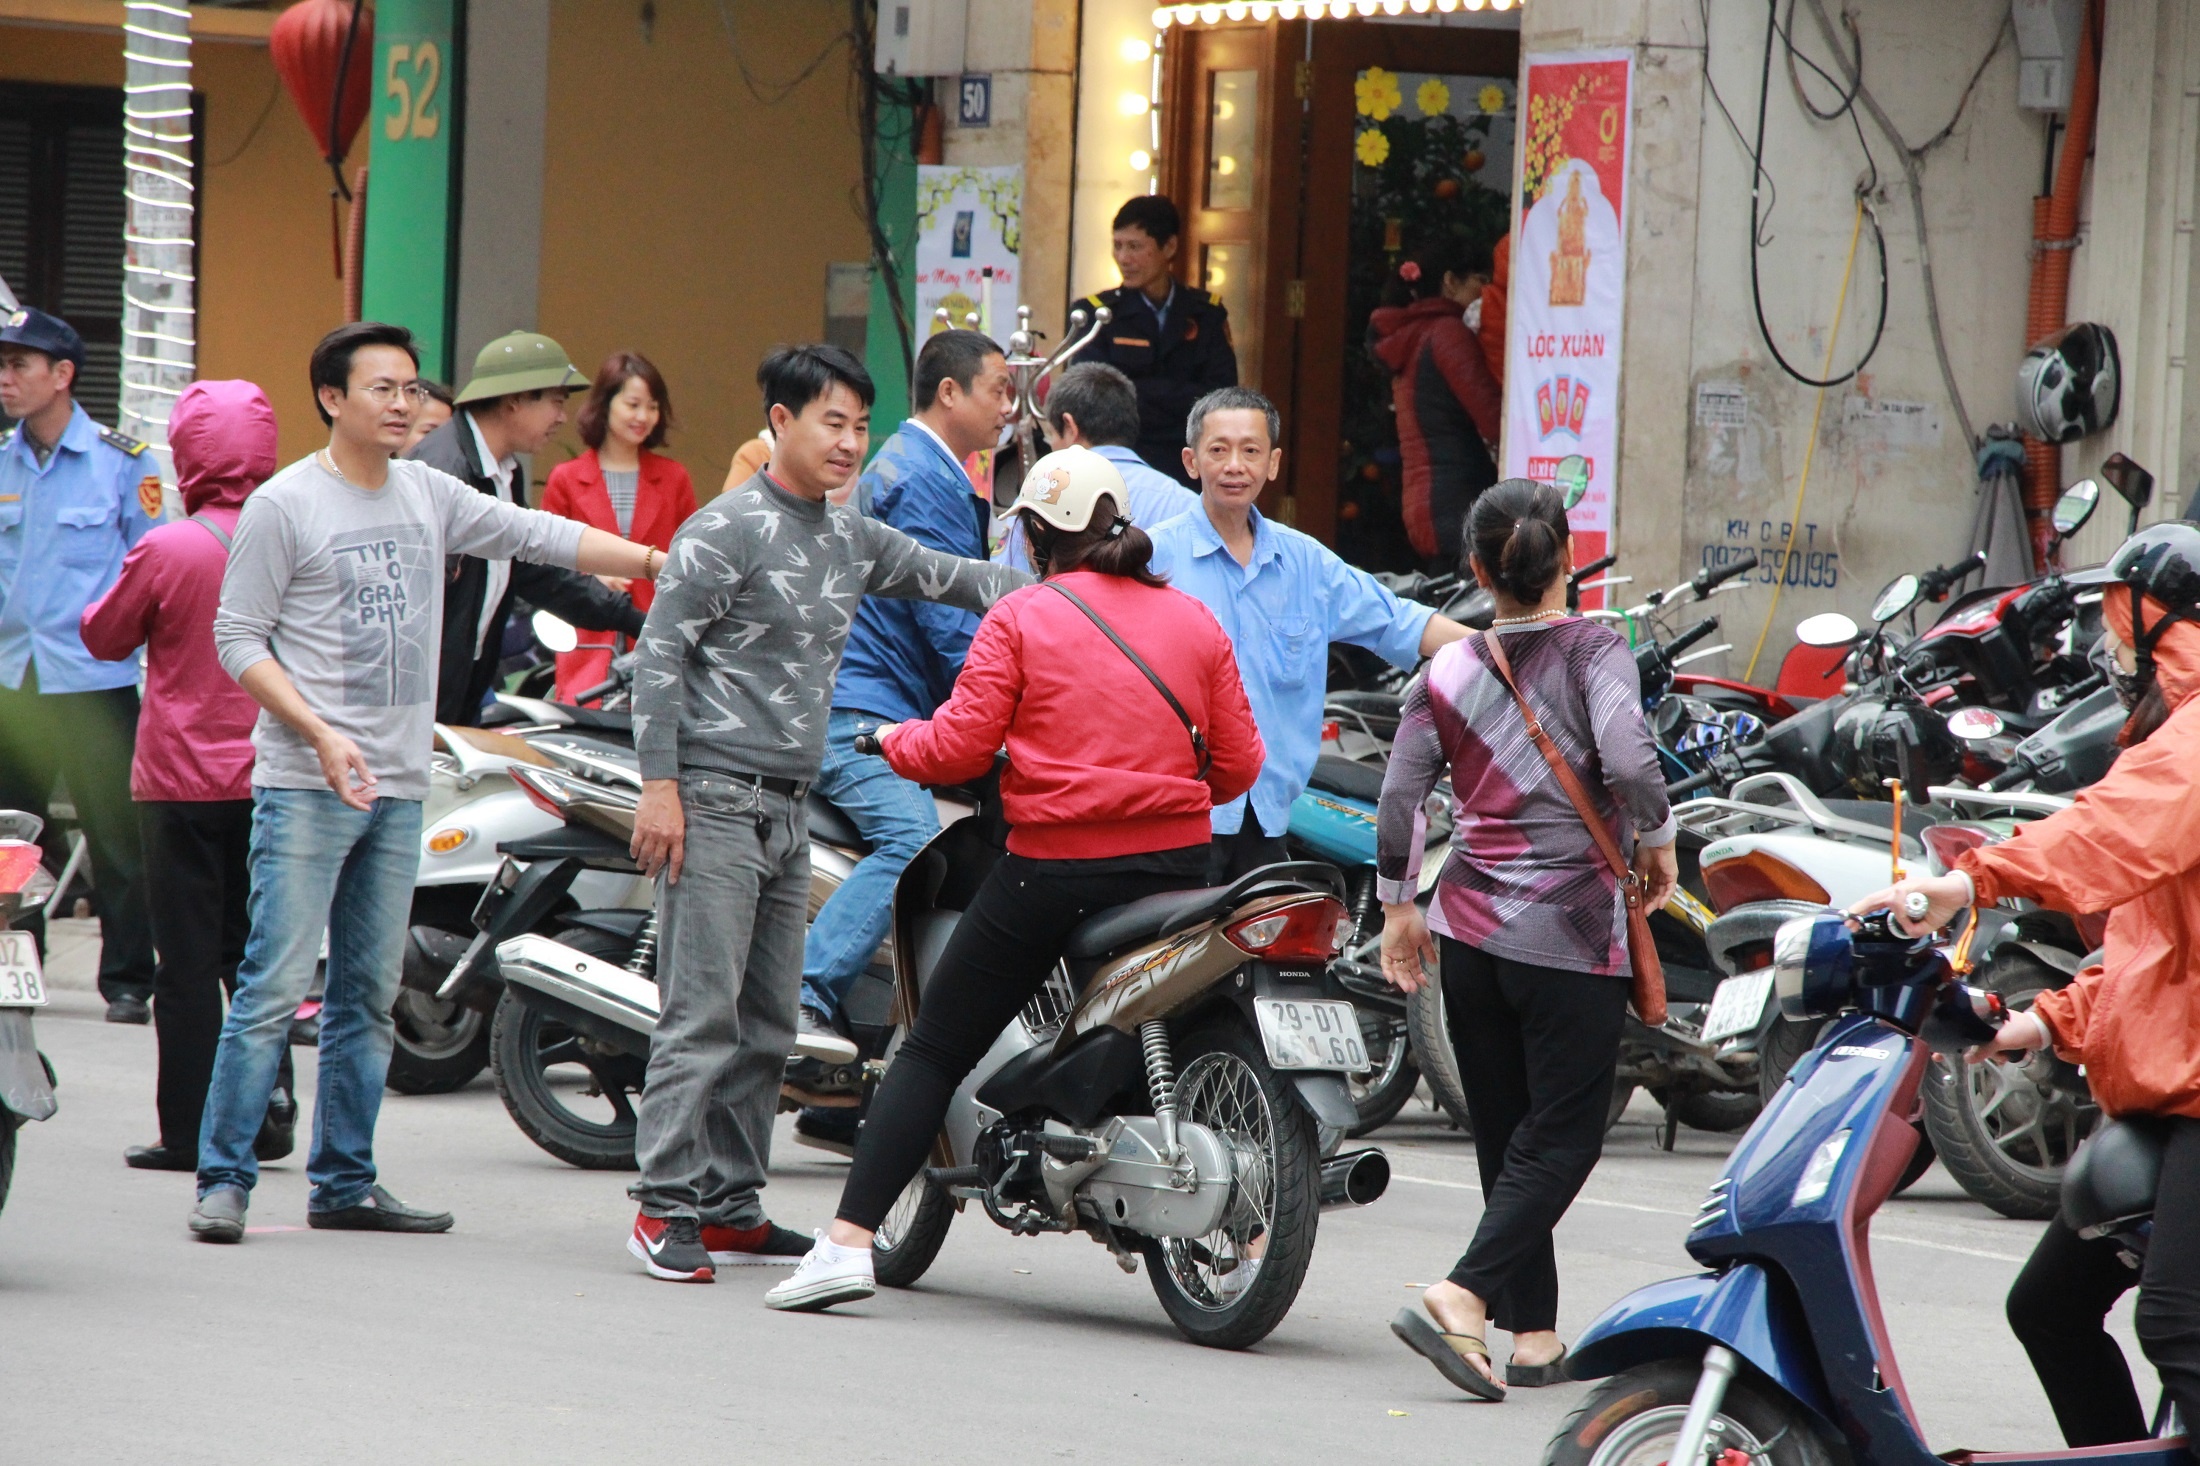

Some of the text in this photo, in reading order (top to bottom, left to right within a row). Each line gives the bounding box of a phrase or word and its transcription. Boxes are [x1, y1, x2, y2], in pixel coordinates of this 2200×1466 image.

[385, 42, 440, 141] 52
[962, 83, 986, 119] 50
[1560, 328, 1605, 358] XUÂN
[333, 540, 397, 563] TYP
[386, 561, 401, 580] O
[358, 583, 406, 605] GRA
[1706, 846, 1735, 860] HONDA
[1271, 1003, 1343, 1034] 29-D1
